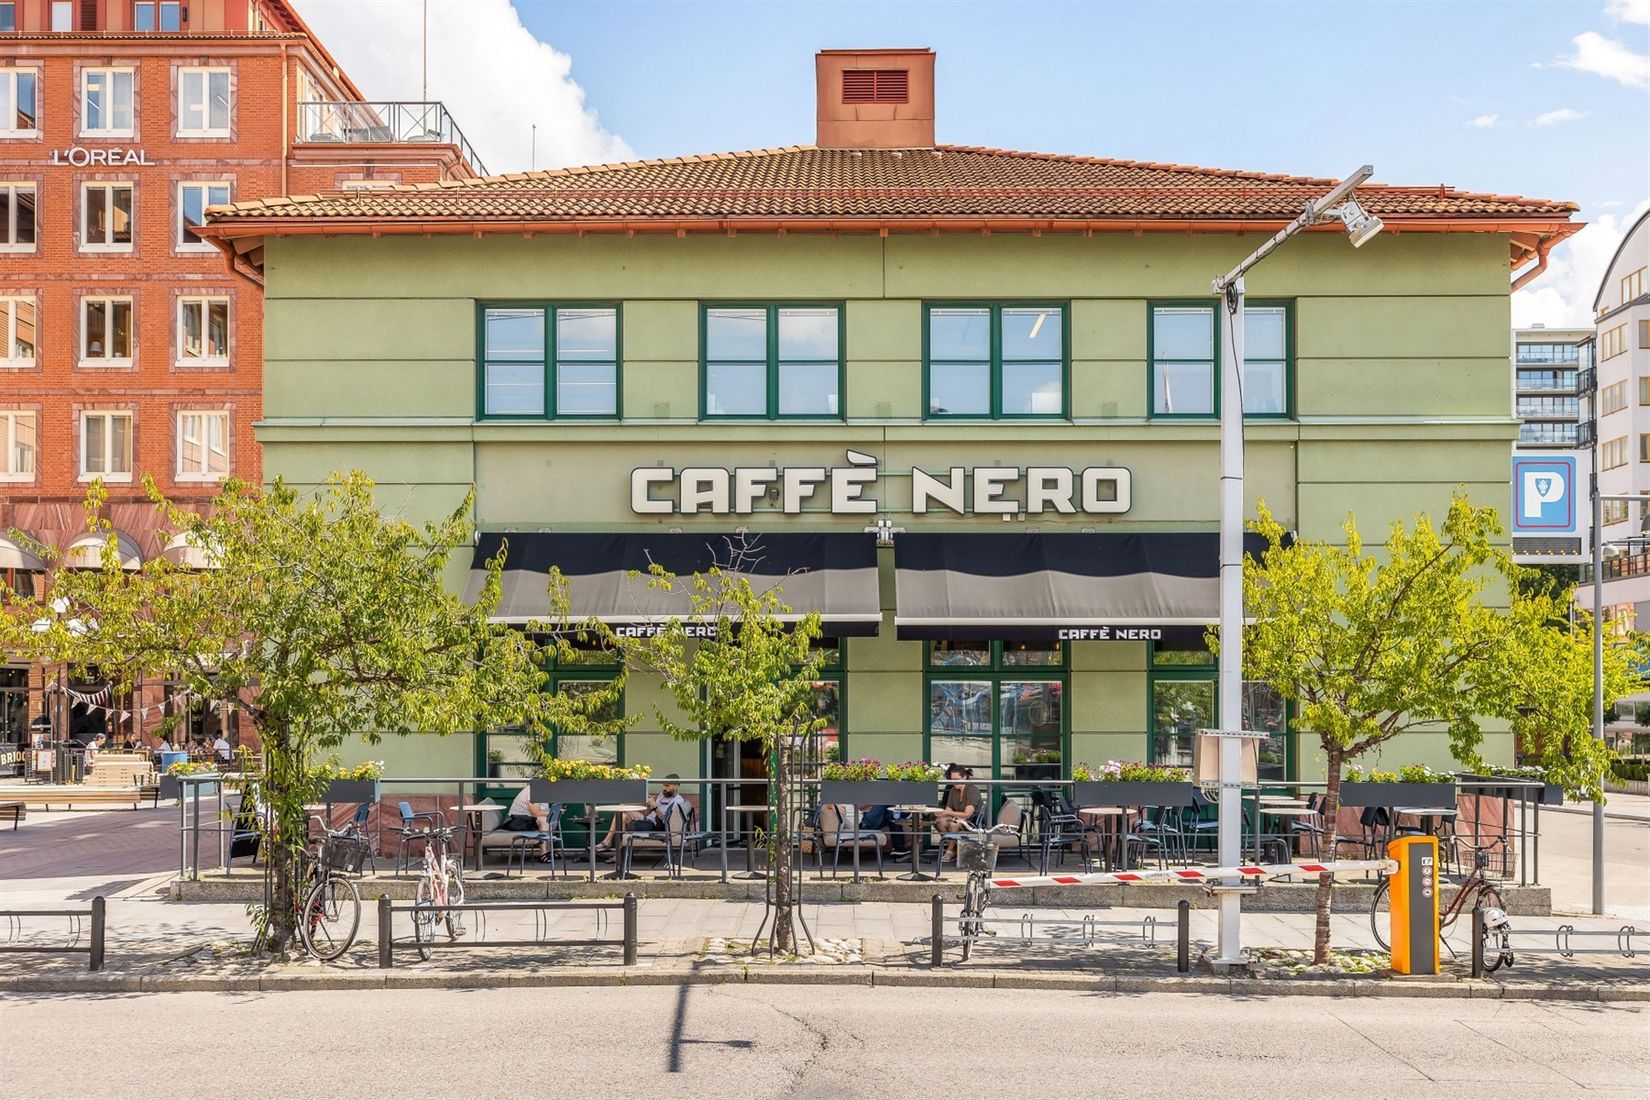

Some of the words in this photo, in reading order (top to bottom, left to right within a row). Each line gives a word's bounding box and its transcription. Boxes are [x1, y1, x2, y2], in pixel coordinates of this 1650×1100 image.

[630, 448, 879, 515] CAFFÈ
[911, 465, 1134, 515] NERO
[1524, 471, 1565, 518] P
[1058, 626, 1110, 640] CAFFÈ
[1115, 629, 1162, 640] NERO
